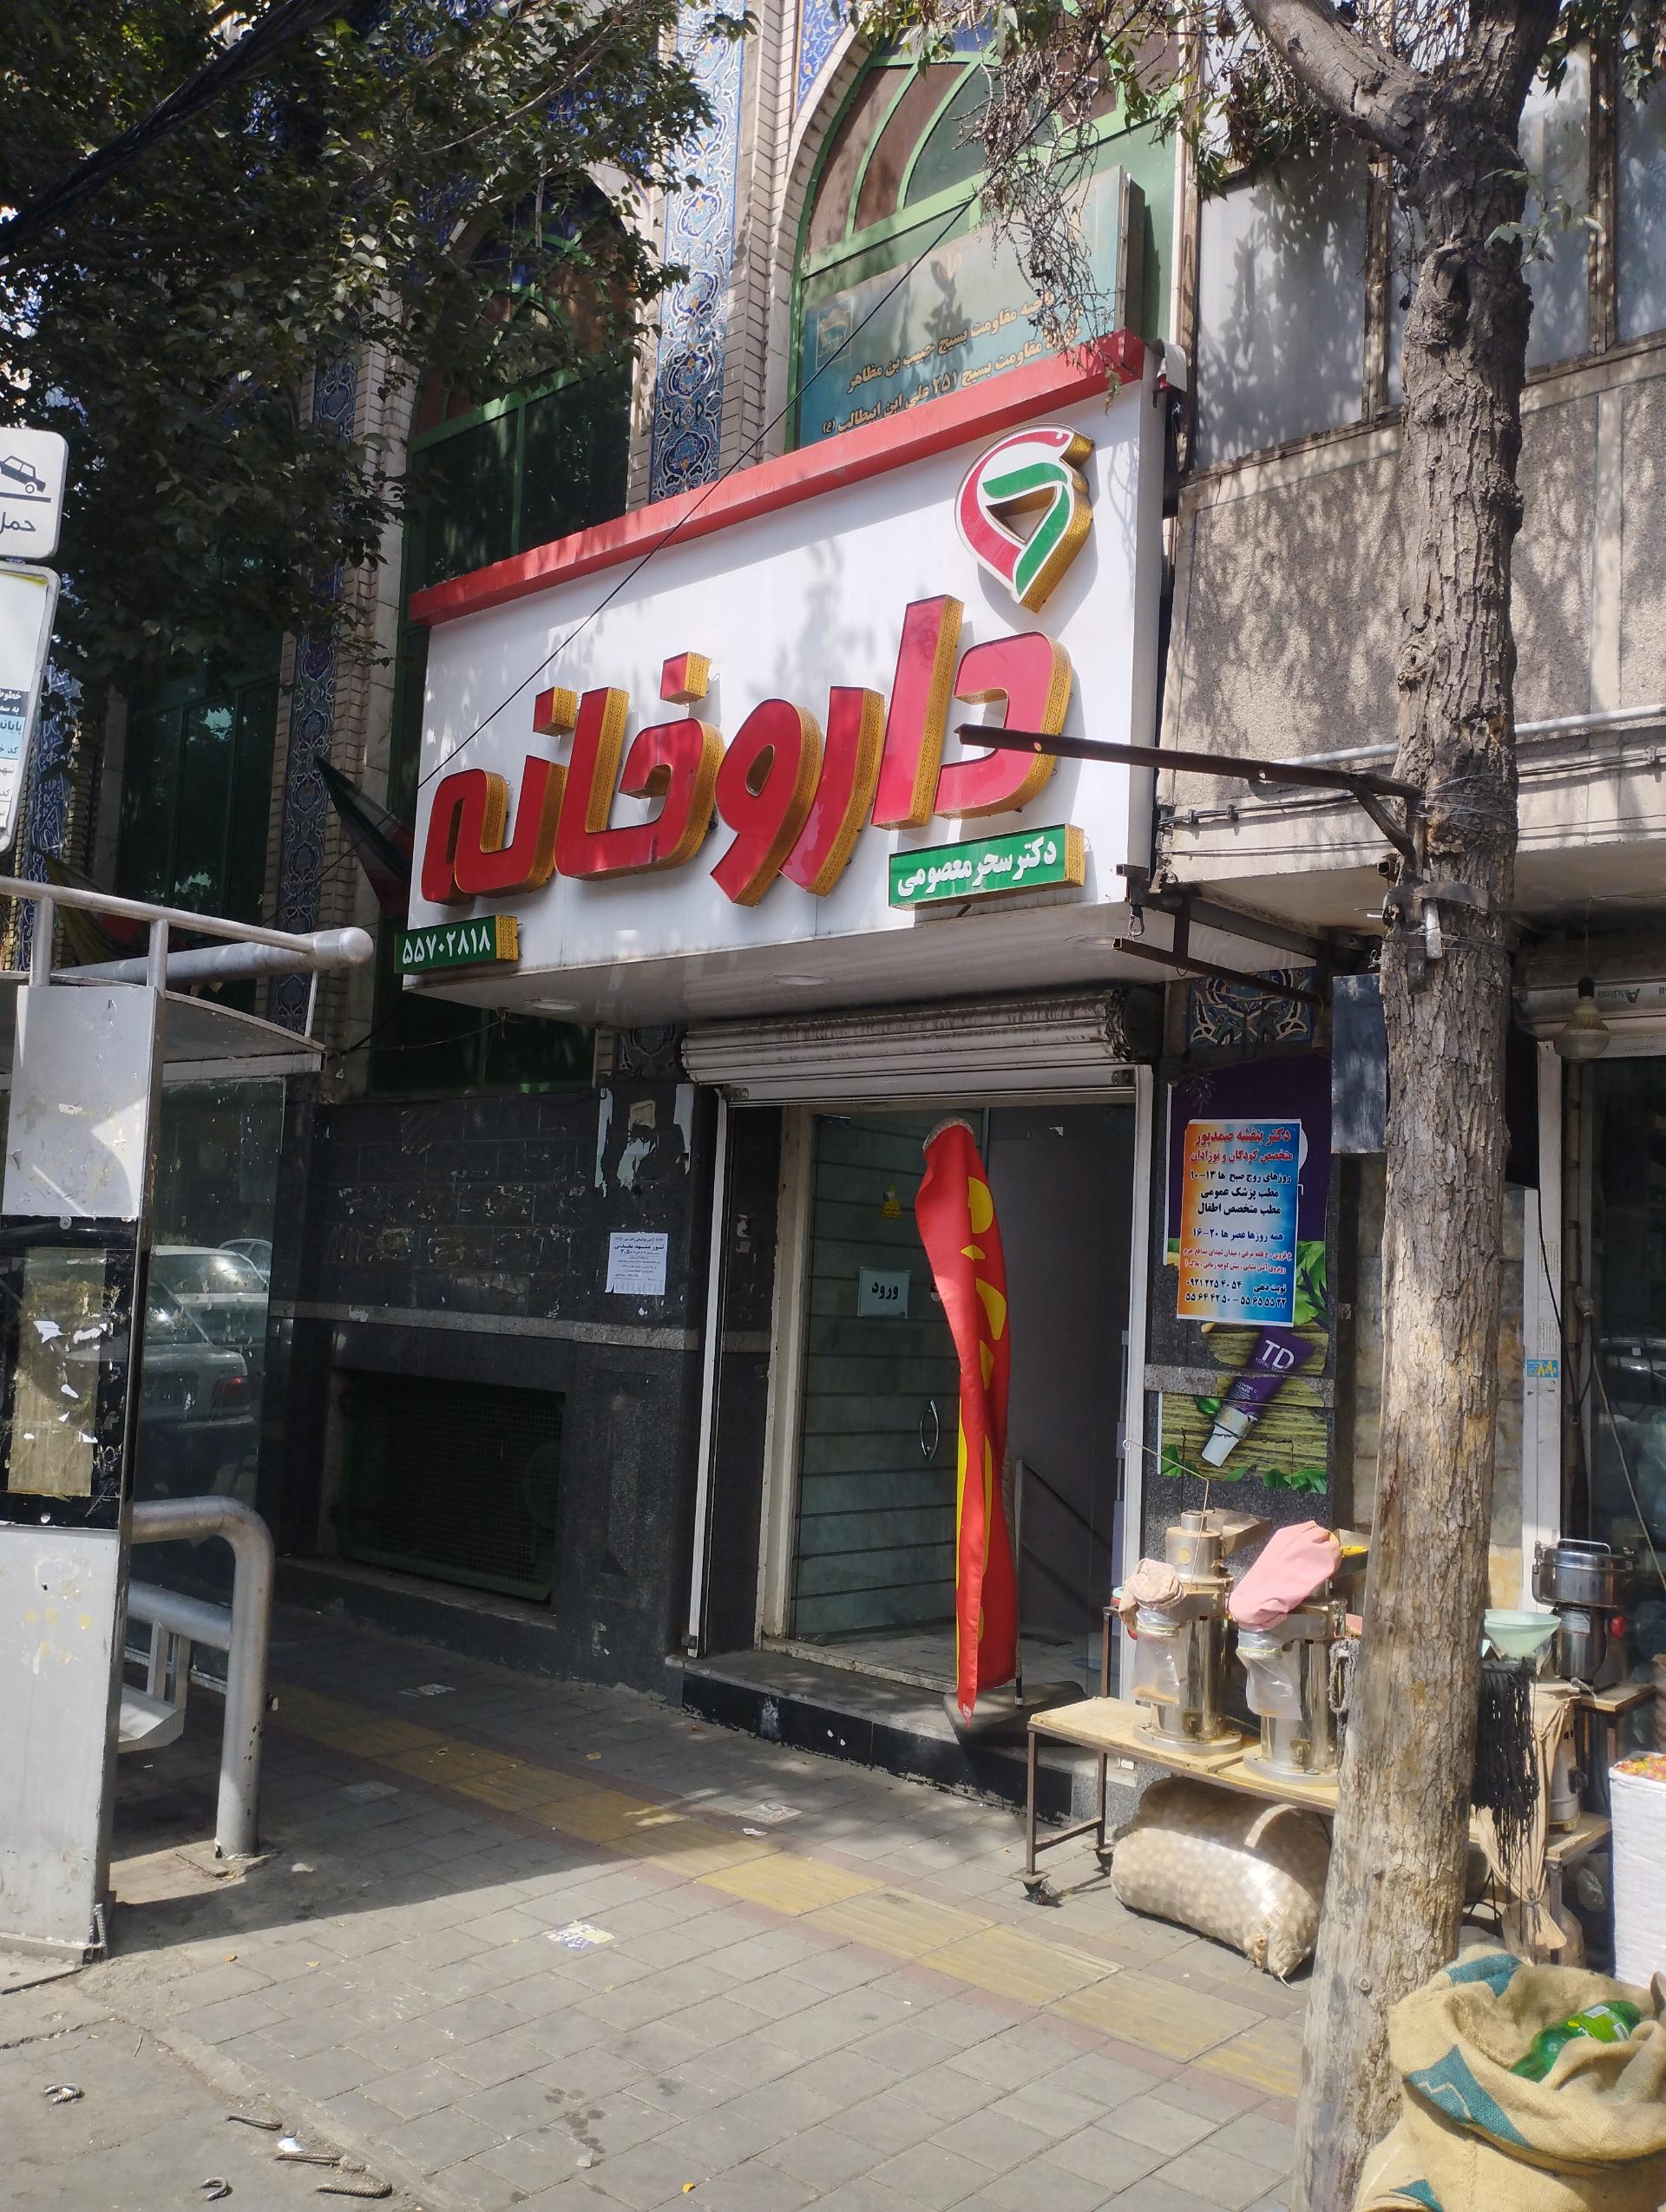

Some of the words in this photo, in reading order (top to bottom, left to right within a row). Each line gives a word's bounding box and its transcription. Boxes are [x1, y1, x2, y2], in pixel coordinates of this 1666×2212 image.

[970, 306, 1018, 338] مقاومت
[938, 329, 968, 355] بسیج
[902, 344, 935, 368] حبیب
[994, 339, 1043, 370] مقاومت
[884, 357, 901, 378] بن
[961, 361, 993, 388] بسیج
[847, 364, 882, 394] مظاهر
[933, 370, 958, 395] ۲۵۱
[883, 392, 902, 417] ابن
[905, 383, 930, 409] علی
[422, 594, 1072, 906] داروخانه
[1012, 835, 1057, 881] دکتر
[972, 851, 1013, 887] سحر
[897, 859, 973, 898] معصومی
[402, 925, 491, 965] ۵۵۷۰۲۸۱۸
[1236, 1129, 1264, 1145] بنفشه
[1266, 1128, 1291, 1146] دکتر
[1190, 1149, 1220, 1162] نوزادان
[1222, 1154, 1226, 1162] و
[1228, 1149, 1258, 1162] کودکان
[1260, 1149, 1293, 1162] متخصص
[1229, 1174, 1244, 1182] صبح
[1246, 1172, 1262, 1183] زوج
[1263, 1171, 1291, 1183] روزهای
[1200, 1188, 1229, 1198] عمومی
[1231, 1187, 1256, 1200] پزشک
[1258, 1188, 1279, 1198] مطب
[1197, 1202, 1222, 1214] اطفال
[1223, 1203, 1257, 1215] متخصص
[1260, 1204, 1281, 1214] مطب
[1230, 1231, 1246, 1240] عصر
[871, 1281, 899, 1300] ورود
[1270, 1283, 1287, 1294] نوبت
[1262, 1339, 1295, 1370] TD
